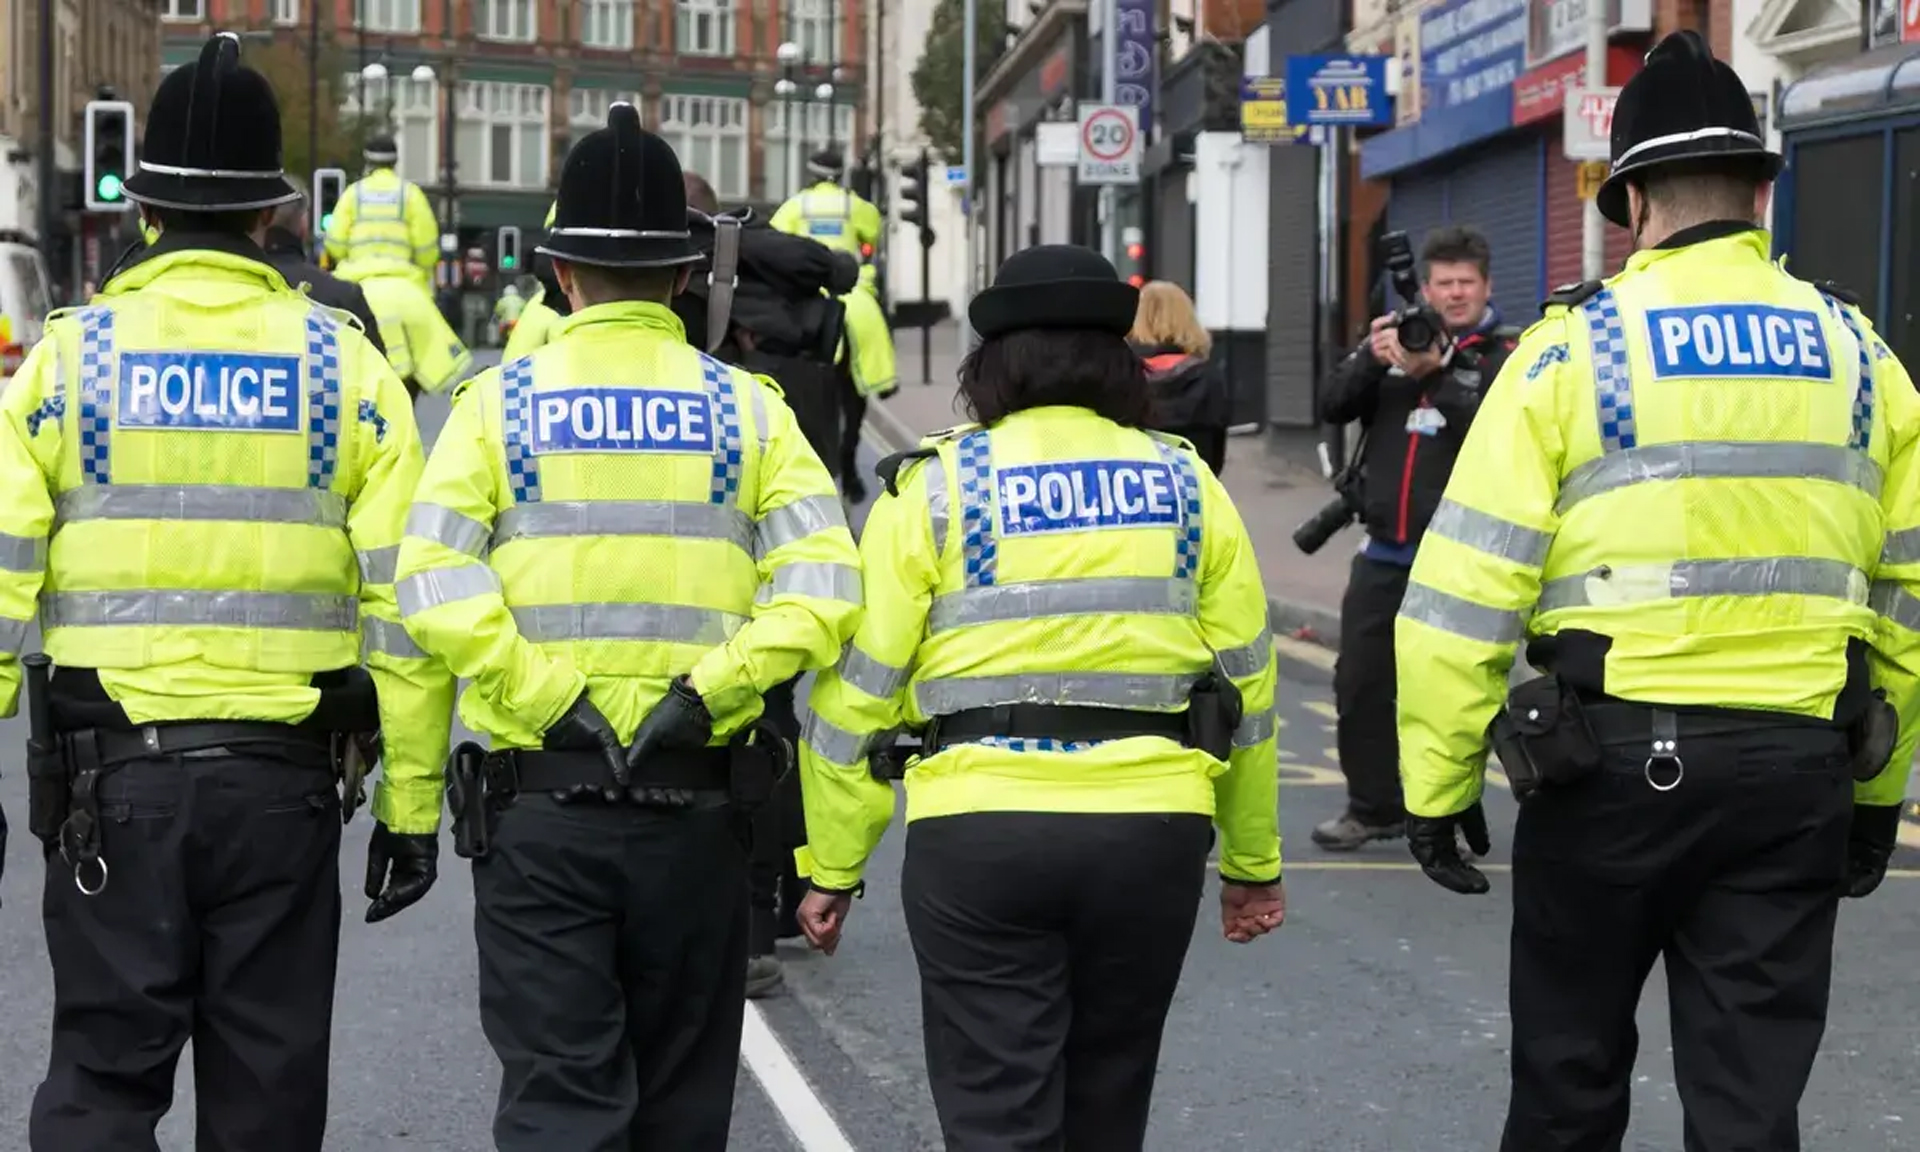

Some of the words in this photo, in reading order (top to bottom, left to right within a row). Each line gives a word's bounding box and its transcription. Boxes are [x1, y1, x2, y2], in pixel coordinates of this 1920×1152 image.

[1093, 124, 1127, 144] 20
[1086, 163, 1130, 175] ZONE
[1659, 313, 1824, 368] POLICE
[130, 364, 289, 417] POLICE
[538, 395, 707, 442] POLICE
[1004, 467, 1172, 525] POLICE
